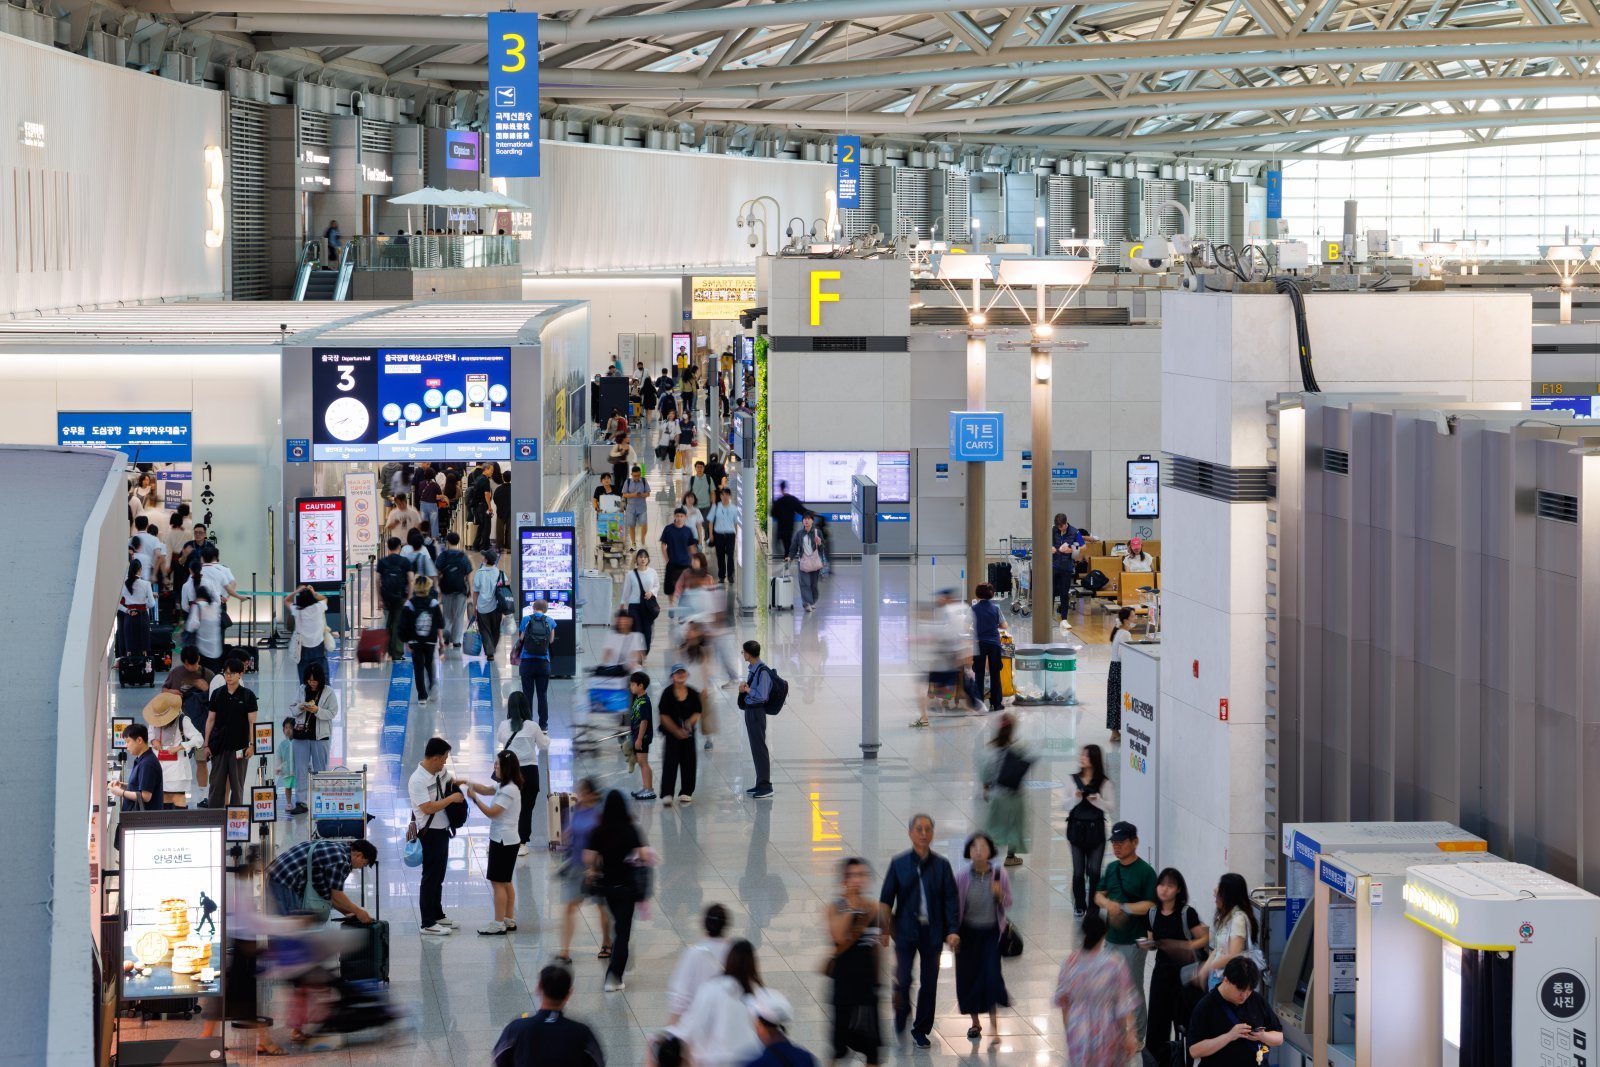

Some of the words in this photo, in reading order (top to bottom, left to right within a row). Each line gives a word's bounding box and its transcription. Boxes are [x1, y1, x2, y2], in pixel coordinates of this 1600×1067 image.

[501, 33, 526, 73] 3
[842, 145, 855, 163] 2
[204, 146, 224, 247] 3
[1328, 243, 1339, 260] B
[810, 271, 841, 326] F
[342, 355, 361, 363] Departure
[336, 365, 356, 392] 3
[1542, 383, 1563, 394] F18
[92, 426, 122, 435] 도심공항
[966, 424, 993, 440] 카트
[966, 441, 993, 449] CARTS
[256, 802, 272, 810] OUT
[229, 821, 247, 829] OUT
[153, 853, 193, 864] 안녕샌드
[1552, 982, 1574, 994] 증명
[1552, 996, 1575, 1009] 사진
[1573, 1027, 1586, 1051] ID
